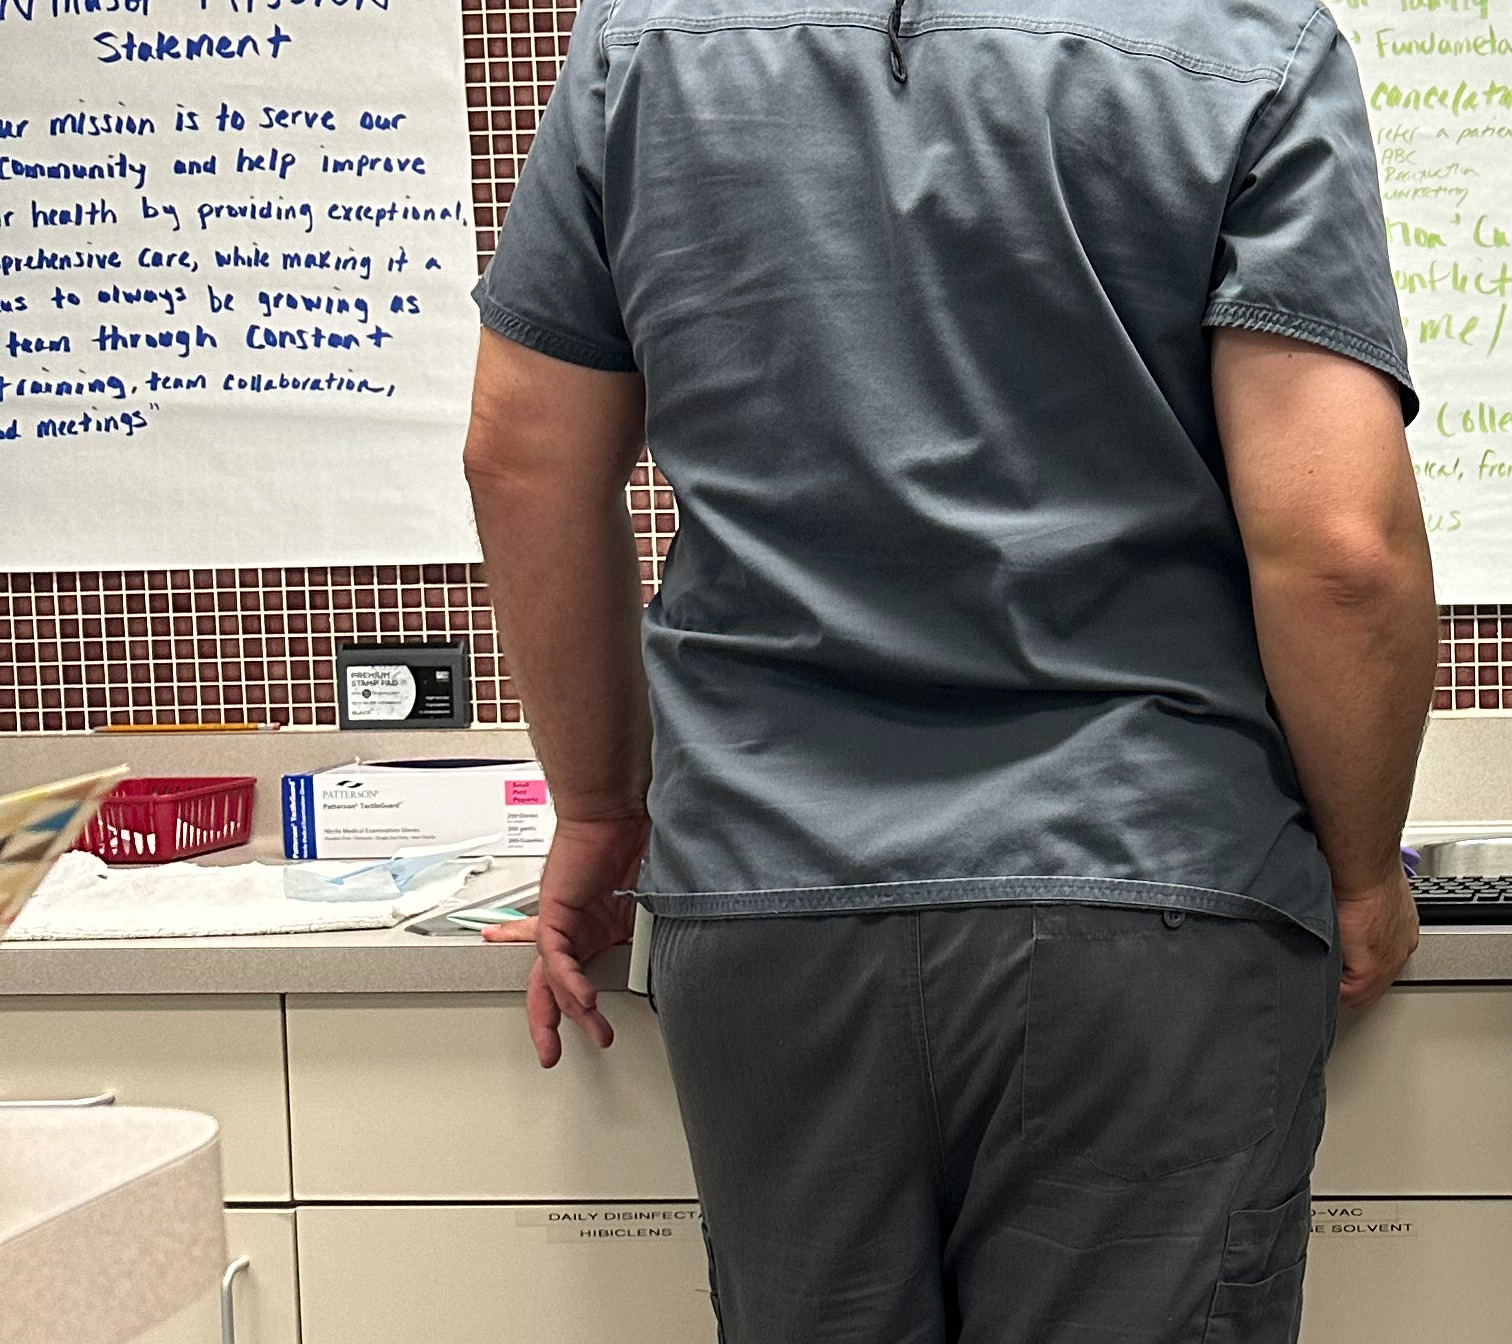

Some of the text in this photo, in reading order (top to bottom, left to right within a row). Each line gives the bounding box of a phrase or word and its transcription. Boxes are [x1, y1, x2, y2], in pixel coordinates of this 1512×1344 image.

[93, 23, 292, 64] Statement
[49, 98, 155, 137] mission
[175, 103, 199, 132] is
[215, 102, 245, 132] to
[258, 106, 336, 131] serve
[359, 111, 407, 131] our
[173, 155, 217, 176] and
[236, 147, 296, 180] help
[320, 144, 426, 177] improve
[31, 198, 118, 228] health
[141, 196, 181, 232] by
[197, 195, 313, 234] providing
[214, 242, 270, 268] while
[282, 247, 371, 280] making
[387, 246, 409, 273] it
[425, 257, 442, 270] a
[50, 286, 81, 309] to
[97, 284, 187, 315] always
[207, 284, 234, 314] be
[258, 286, 369, 324] growing
[390, 295, 421, 315] as
[5, 330, 71, 358] team
[91, 324, 218, 358] through
[145, 371, 207, 392] team
[548, 1212, 598, 1222] DAILY
[580, 1228, 672, 1238] HIBICLENS
[1331, 1223, 1414, 1233] SOLVENT
